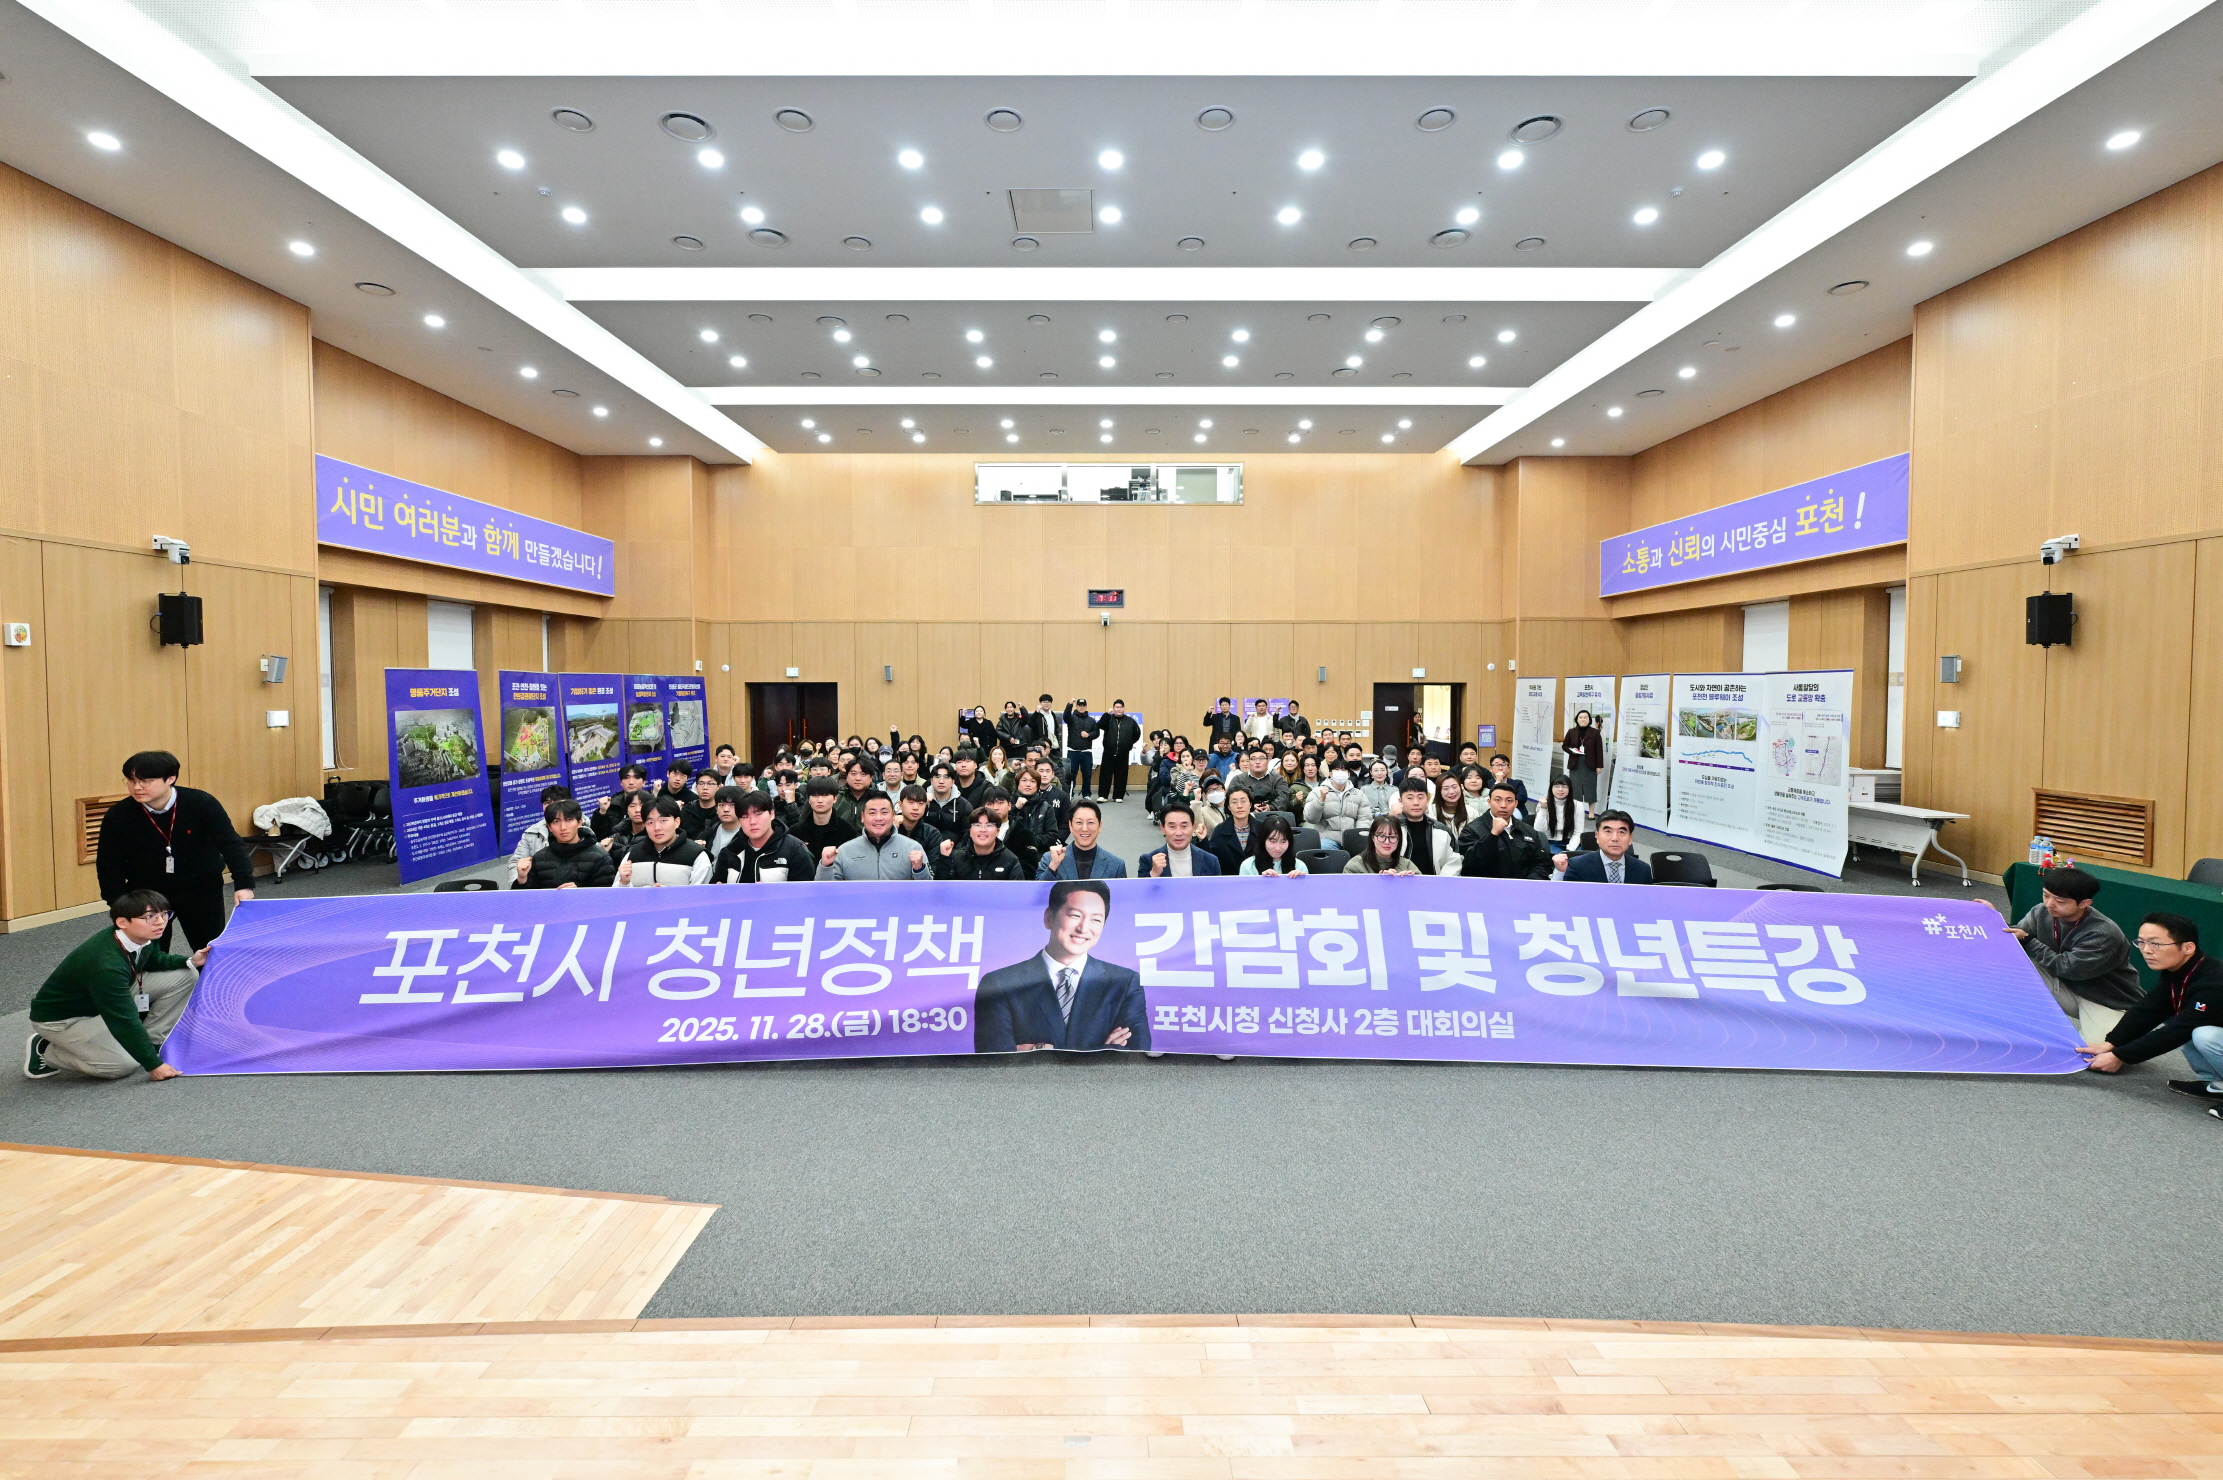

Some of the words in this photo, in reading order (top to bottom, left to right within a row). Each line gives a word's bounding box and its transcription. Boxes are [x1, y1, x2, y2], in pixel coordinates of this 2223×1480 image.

[331, 478, 384, 531] 시민
[394, 494, 477, 550] 여러분과
[483, 518, 519, 560] 함께
[525, 539, 603, 580] 만들겠습니다!
[1622, 539, 1662, 574] 소통과
[1668, 527, 1715, 567] 신뢰의
[1720, 517, 1786, 553] 시민중심
[1795, 489, 1844, 536] 포천
[448, 687, 459, 697] 조성
[1690, 684, 1706, 692] 도시와
[1706, 684, 1723, 692] 자연이
[1724, 684, 1747, 692] 공존하는
[1793, 683, 1819, 692] 사통팔달의
[1692, 693, 1708, 701] 포천천
[1732, 693, 1744, 701] 조성
[1786, 693, 1797, 702] 도로
[1797, 694, 1813, 702] 교통망
[1944, 924, 1988, 939] 포천시
[359, 921, 627, 1004] 포천시
[646, 915, 985, 1000] 청년정책
[1134, 908, 1388, 991] 간담회
[1408, 910, 1497, 994] 및
[1513, 913, 1867, 1005] 청년특강
[657, 1016, 739, 1043] 2025.
[749, 1015, 778, 1040] 11.
[785, 1009, 882, 1038] 28.(금)
[889, 1006, 967, 1033] 18:30
[1153, 1005, 1260, 1034] 포천시청
[1268, 1006, 1348, 1035] 신청사
[1354, 1008, 1399, 1037] 2층
[1406, 1009, 1515, 1039] 대회의실
